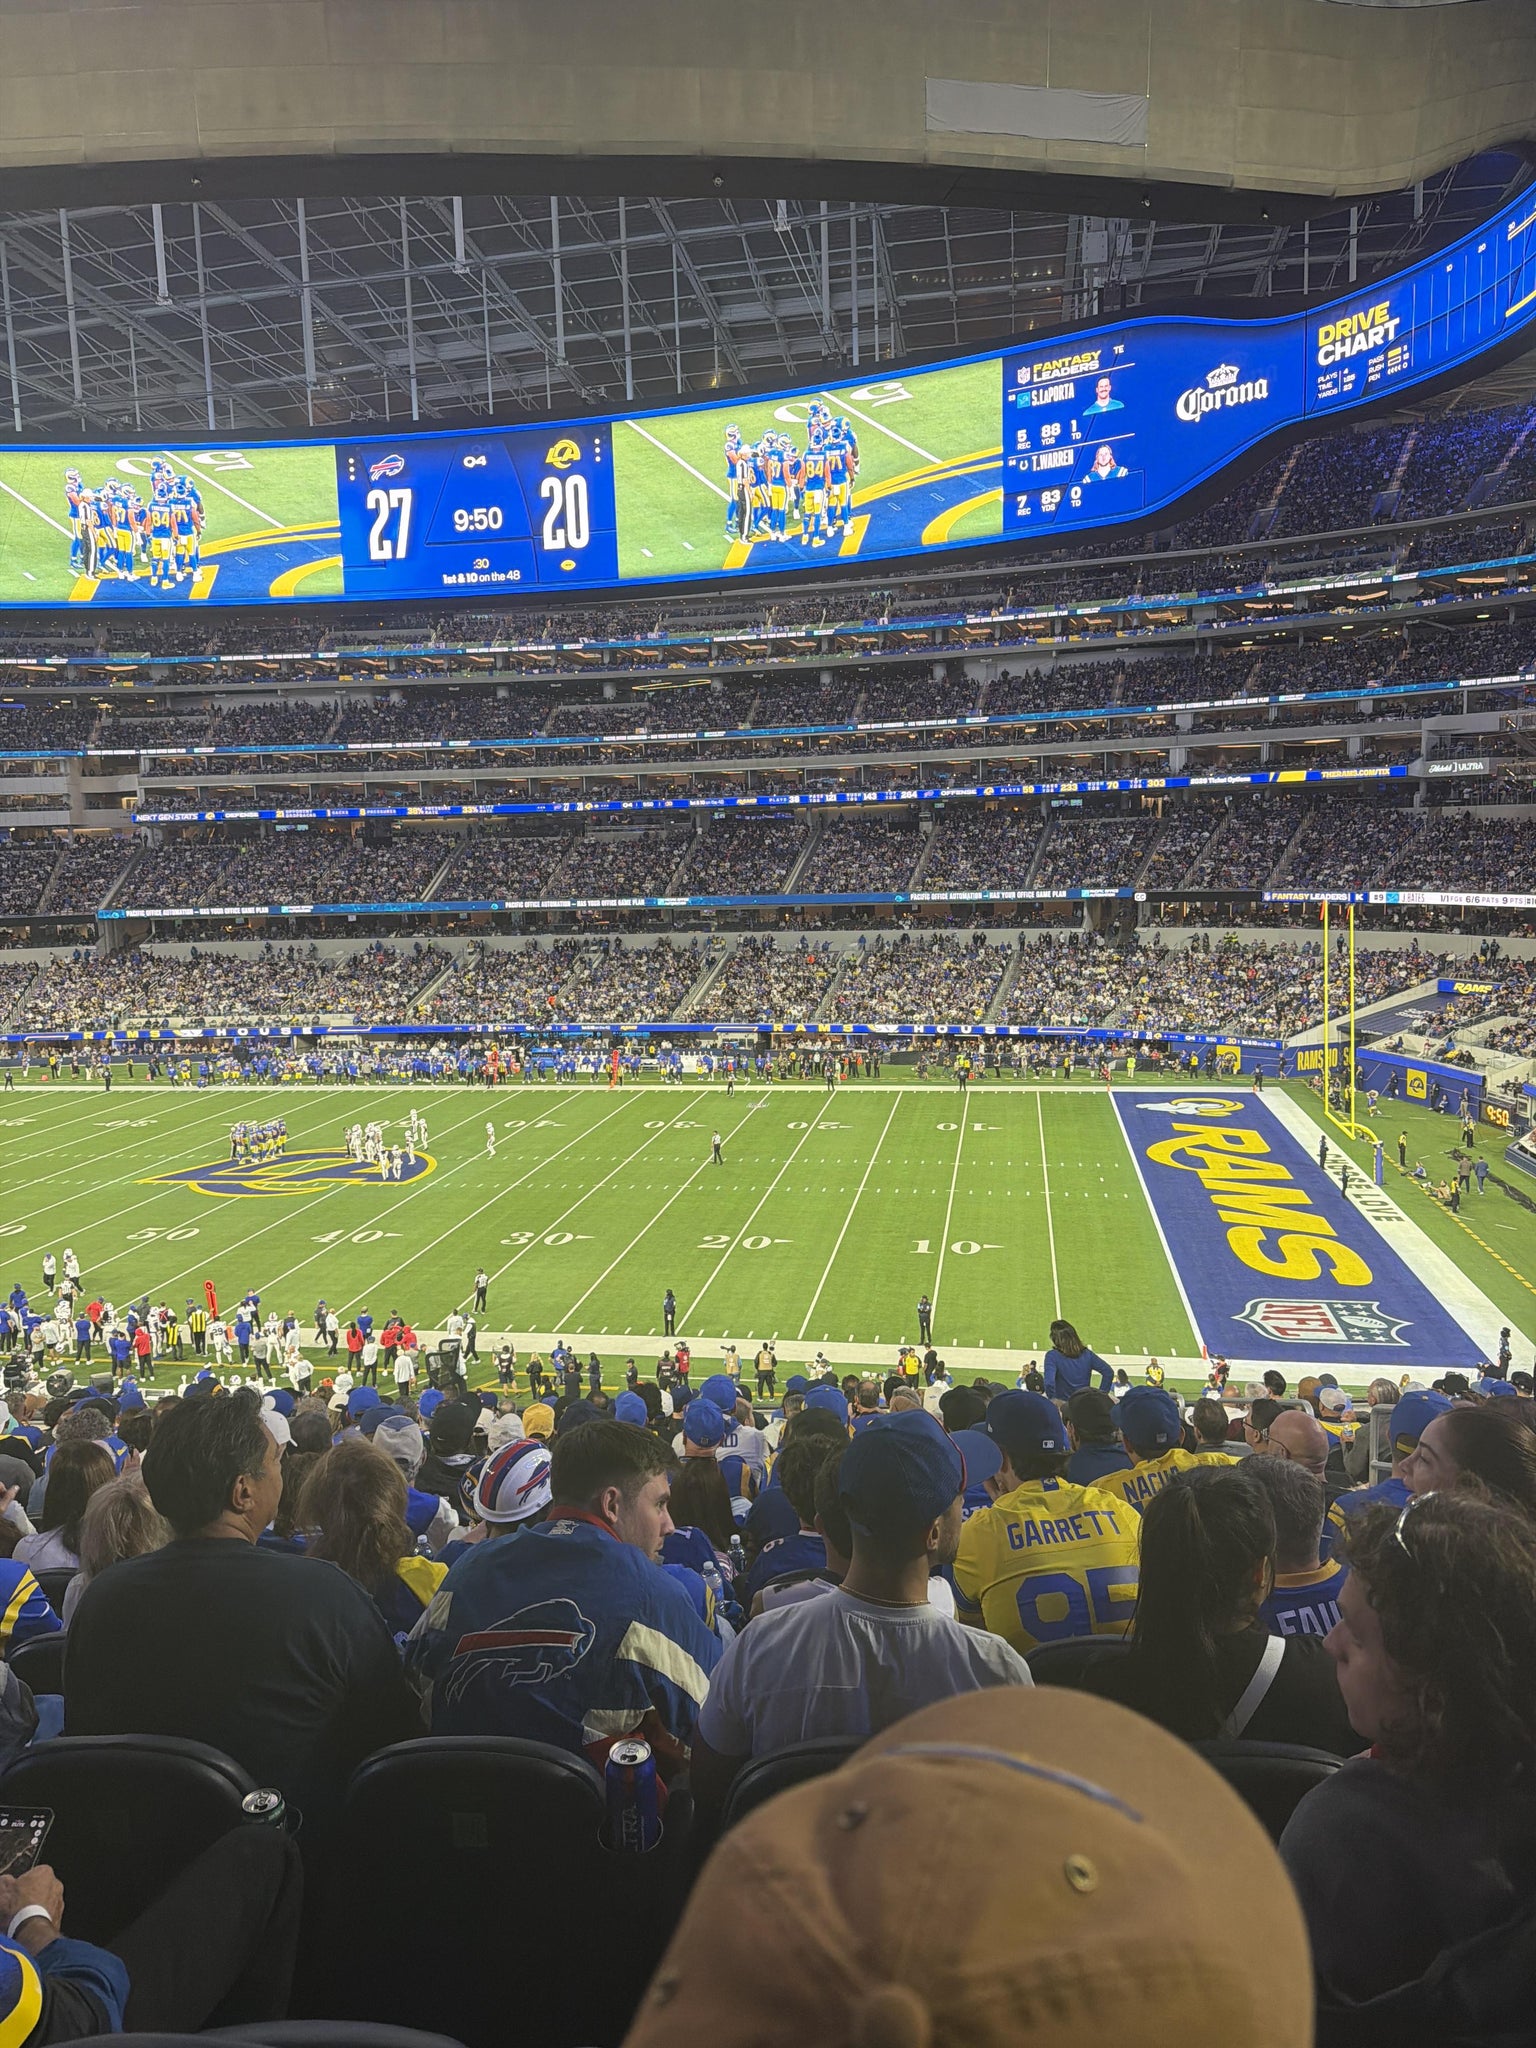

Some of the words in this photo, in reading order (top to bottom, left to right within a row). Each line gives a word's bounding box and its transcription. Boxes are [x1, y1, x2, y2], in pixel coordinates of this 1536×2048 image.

[1318, 301, 1390, 347] DRIVE
[1317, 317, 1400, 366] CHART
[1113, 344, 1125, 355] TE
[1033, 350, 1101, 374] FANTASY
[1368, 354, 1384, 366] PASS
[1033, 360, 1100, 382] LEADERS
[1368, 363, 1384, 374] RUSH
[1318, 372, 1338, 383] PLAYS
[1368, 373, 1380, 382] PEN
[1318, 381, 1333, 391] TIME
[1176, 377, 1269, 423] Corona
[1317, 388, 1338, 399] YARDS
[1017, 429, 1027, 442] 5
[1041, 423, 1061, 437] 88
[1071, 420, 1077, 432] 1
[1017, 441, 1031, 450] REC
[1041, 437, 1055, 446] YDS
[463, 455, 487, 468] Q4
[1031, 449, 1074, 471] T.WARREN
[806, 461, 824, 478] 84
[1017, 495, 1027, 508] 7
[1041, 490, 1061, 504] 83
[1071, 486, 1082, 499] 0
[541, 474, 590, 550] 20
[1017, 508, 1031, 516] REC
[1041, 503, 1055, 512] YDS
[151, 511, 170, 528] 84
[367, 488, 412, 560] 27
[454, 506, 503, 532] 9:50
[443, 574, 456, 584] 1st
[466, 571, 478, 582] 10
[479, 573, 490, 582] on
[491, 570, 506, 581] the
[506, 569, 521, 581] 48
[1458, 761, 1484, 771] ULTRA
[1107, 781, 1119, 789] 70
[1147, 779, 1166, 787] 303
[1228, 776, 1251, 784] Options
[1060, 783, 1078, 791] 233
[863, 792, 877, 800] 143
[158, 813, 175, 821] GEN
[175, 812, 198, 820] STATS
[910, 892, 930, 900] PACIFIC
[931, 892, 948, 900] OFFICE
[950, 891, 982, 900] AUTOMATION
[989, 891, 1000, 899] HAS
[1002, 891, 1016, 899] YOUR
[1017, 890, 1035, 899] OFFICE
[1036, 889, 1051, 898] GAME
[1052, 889, 1067, 898] PLAN
[1466, 895, 1480, 903] 6/6
[505, 901, 523, 909] PACIFIC
[541, 900, 571, 908] AUTOMATION
[601, 899, 617, 907] OFFICE
[1453, 982, 1493, 994] RAMS
[84, 1029, 161, 1040] RAMS
[217, 1026, 312, 1036] HOUSE
[773, 1024, 853, 1032] RAMS
[914, 1025, 1020, 1034] HOUSE
[1297, 1049, 1324, 1071] RAMS
[1486, 1105, 1509, 1126] 9:50
[787, 1121, 842, 1130] 20
[936, 1122, 987, 1131] 10
[1146, 1123, 1373, 1286] RAMS
[1352, 1194, 1405, 1222] LOVE
[127, 1227, 200, 1241] 50
[311, 1230, 384, 1243] 40
[500, 1231, 575, 1245] 30
[697, 1234, 772, 1250] 20
[910, 1239, 982, 1255] 10
[1261, 1303, 1337, 1337] NFL
[1006, 1510, 1122, 1550] GARRETT
